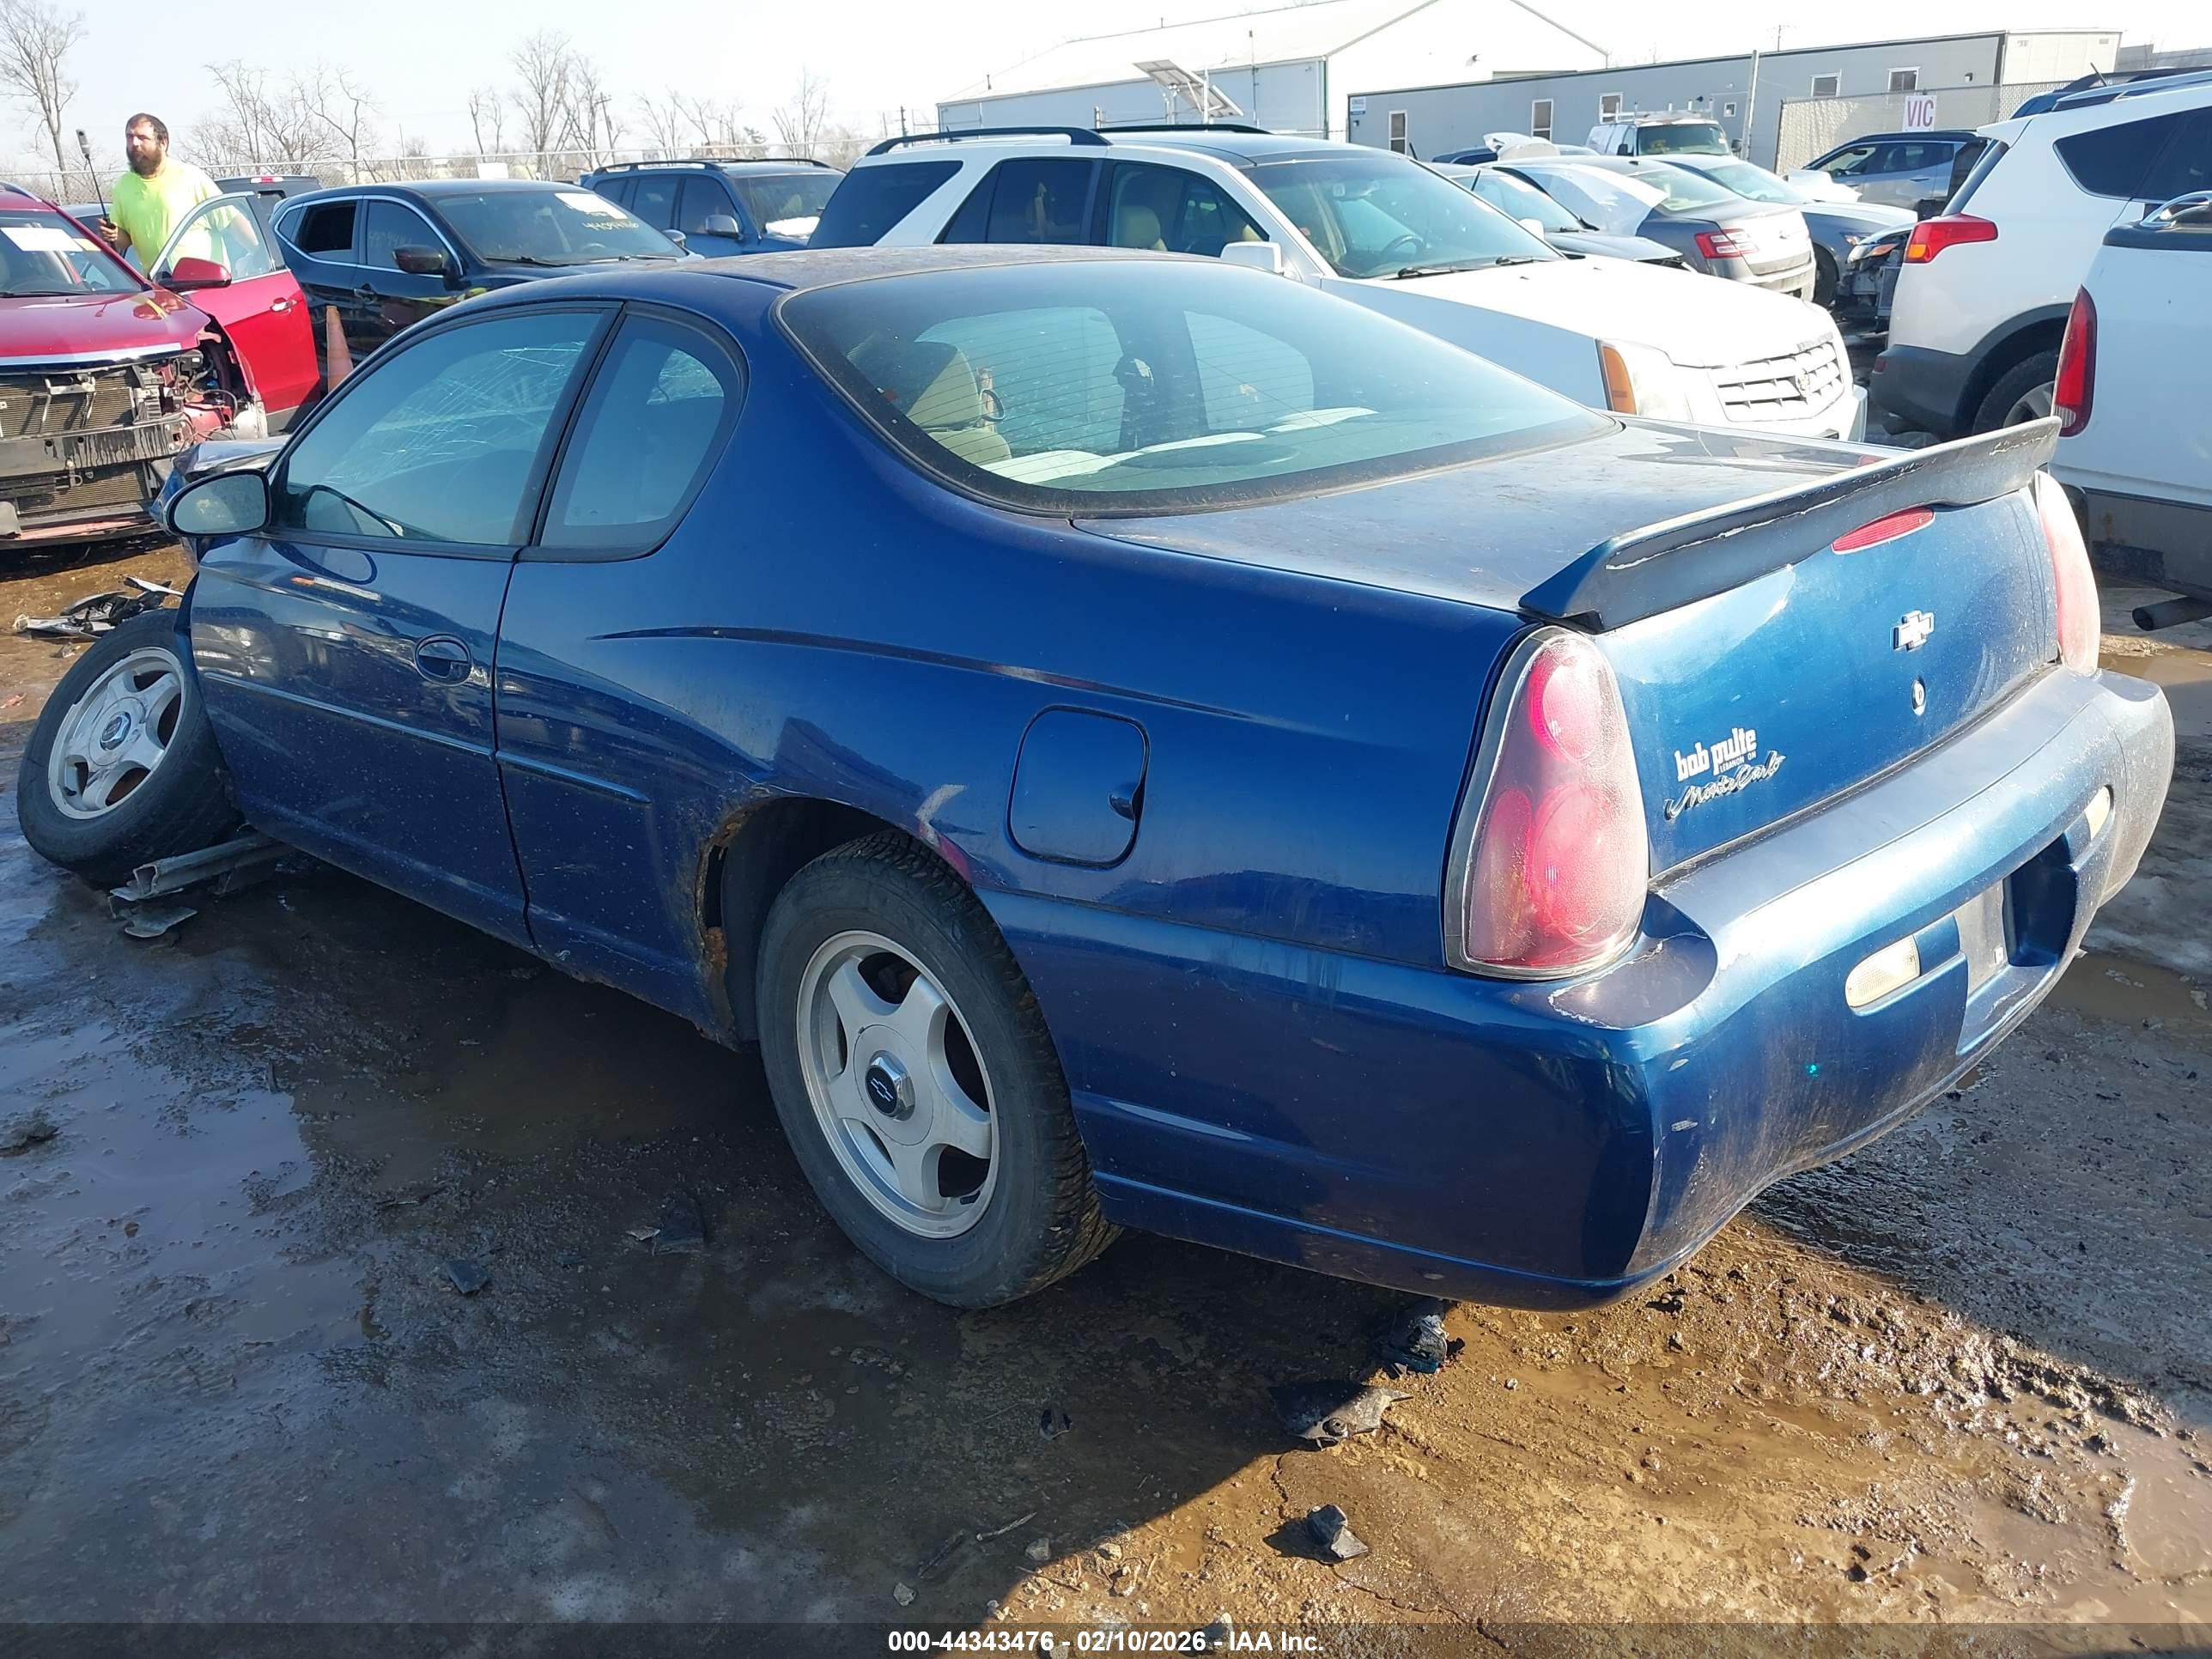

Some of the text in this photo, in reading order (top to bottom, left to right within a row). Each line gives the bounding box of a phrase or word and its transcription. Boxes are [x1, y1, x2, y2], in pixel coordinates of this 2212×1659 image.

[1907, 100, 1934, 127] VIC
[1674, 727, 1758, 782] bob pulte
[1734, 750, 1786, 793] Carlo
